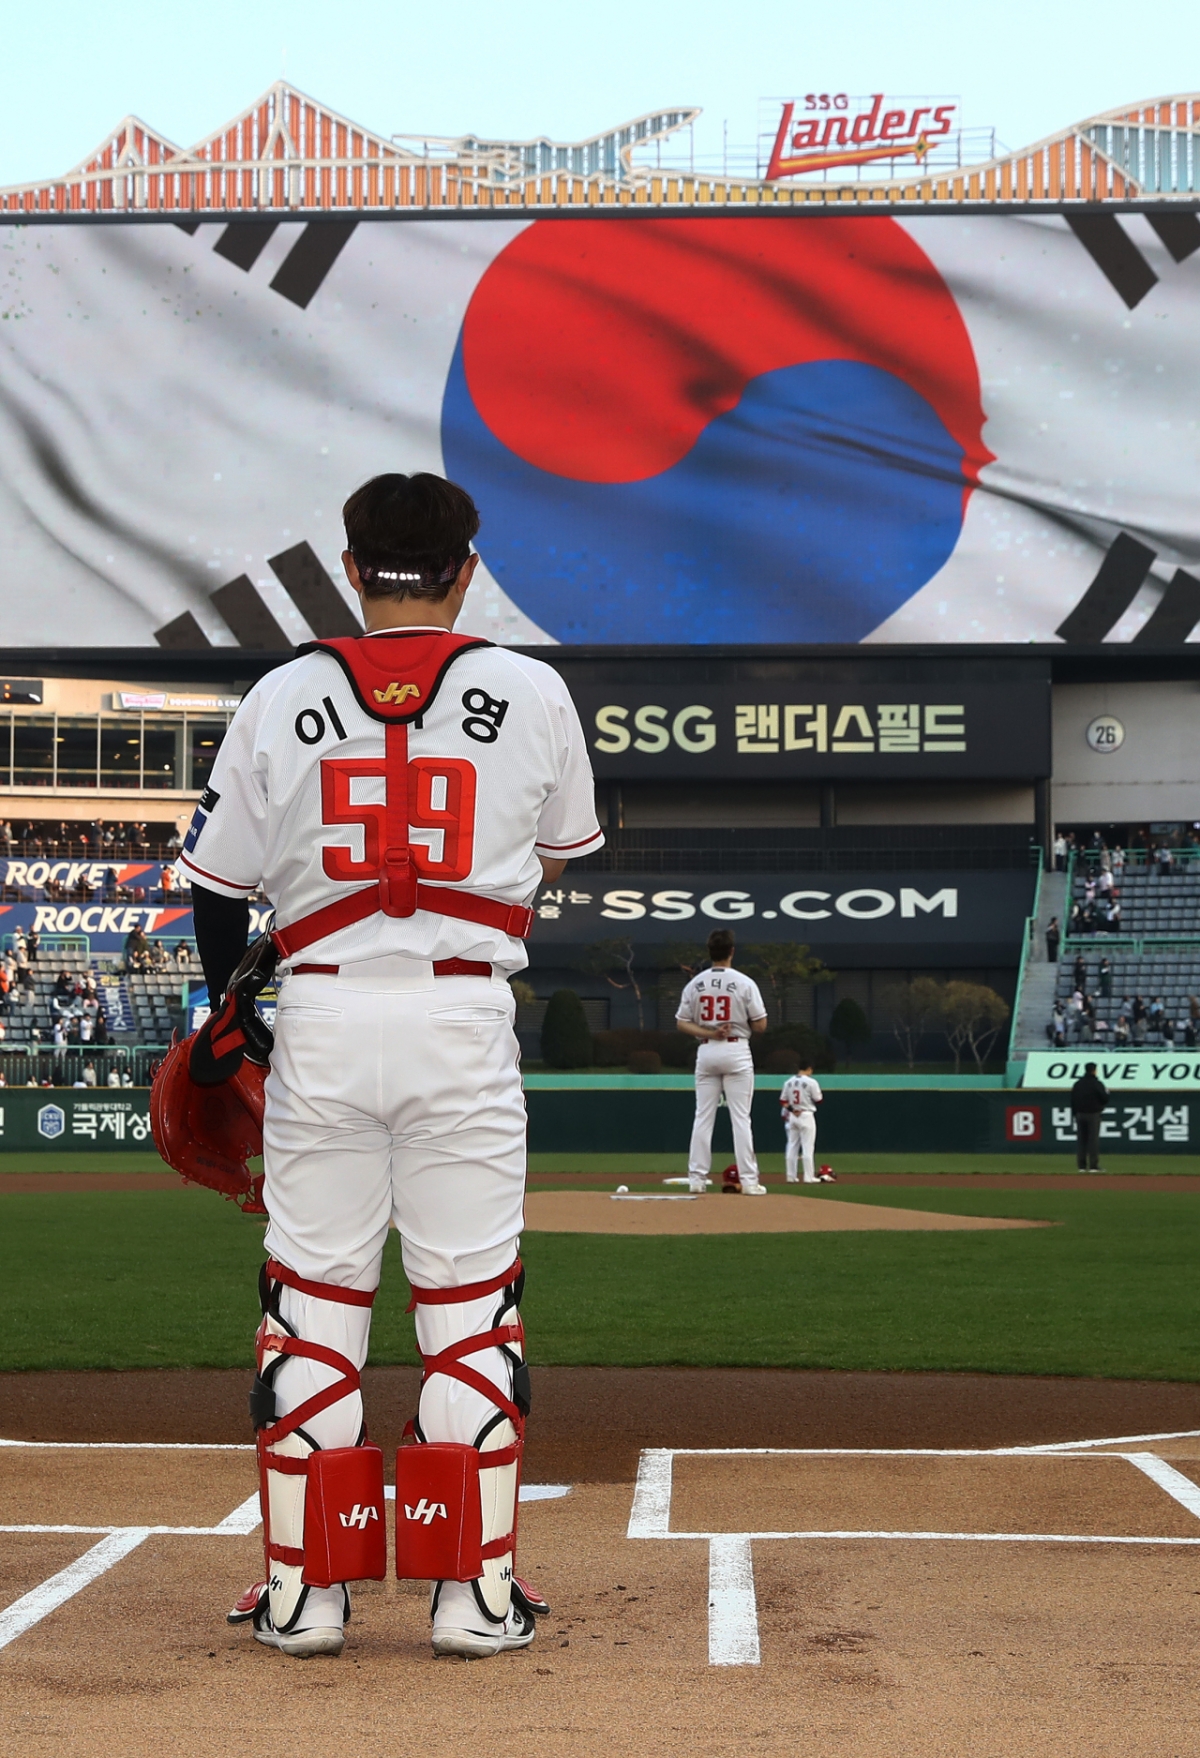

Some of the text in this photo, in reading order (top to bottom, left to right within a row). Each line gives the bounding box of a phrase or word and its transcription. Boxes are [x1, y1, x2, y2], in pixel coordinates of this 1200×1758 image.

[805, 94, 848, 110] SSG
[765, 93, 956, 180] Landers
[295, 688, 509, 744] 이영
[594, 704, 966, 753] SSG 랜더스필드
[1095, 725, 1116, 744] 26
[320, 756, 477, 882] 59
[34, 906, 164, 933] ROCKET
[540, 888, 957, 921] 사는 SSG.COM
[699, 995, 731, 1021] 33
[1046, 1062, 1140, 1080] OLVE
